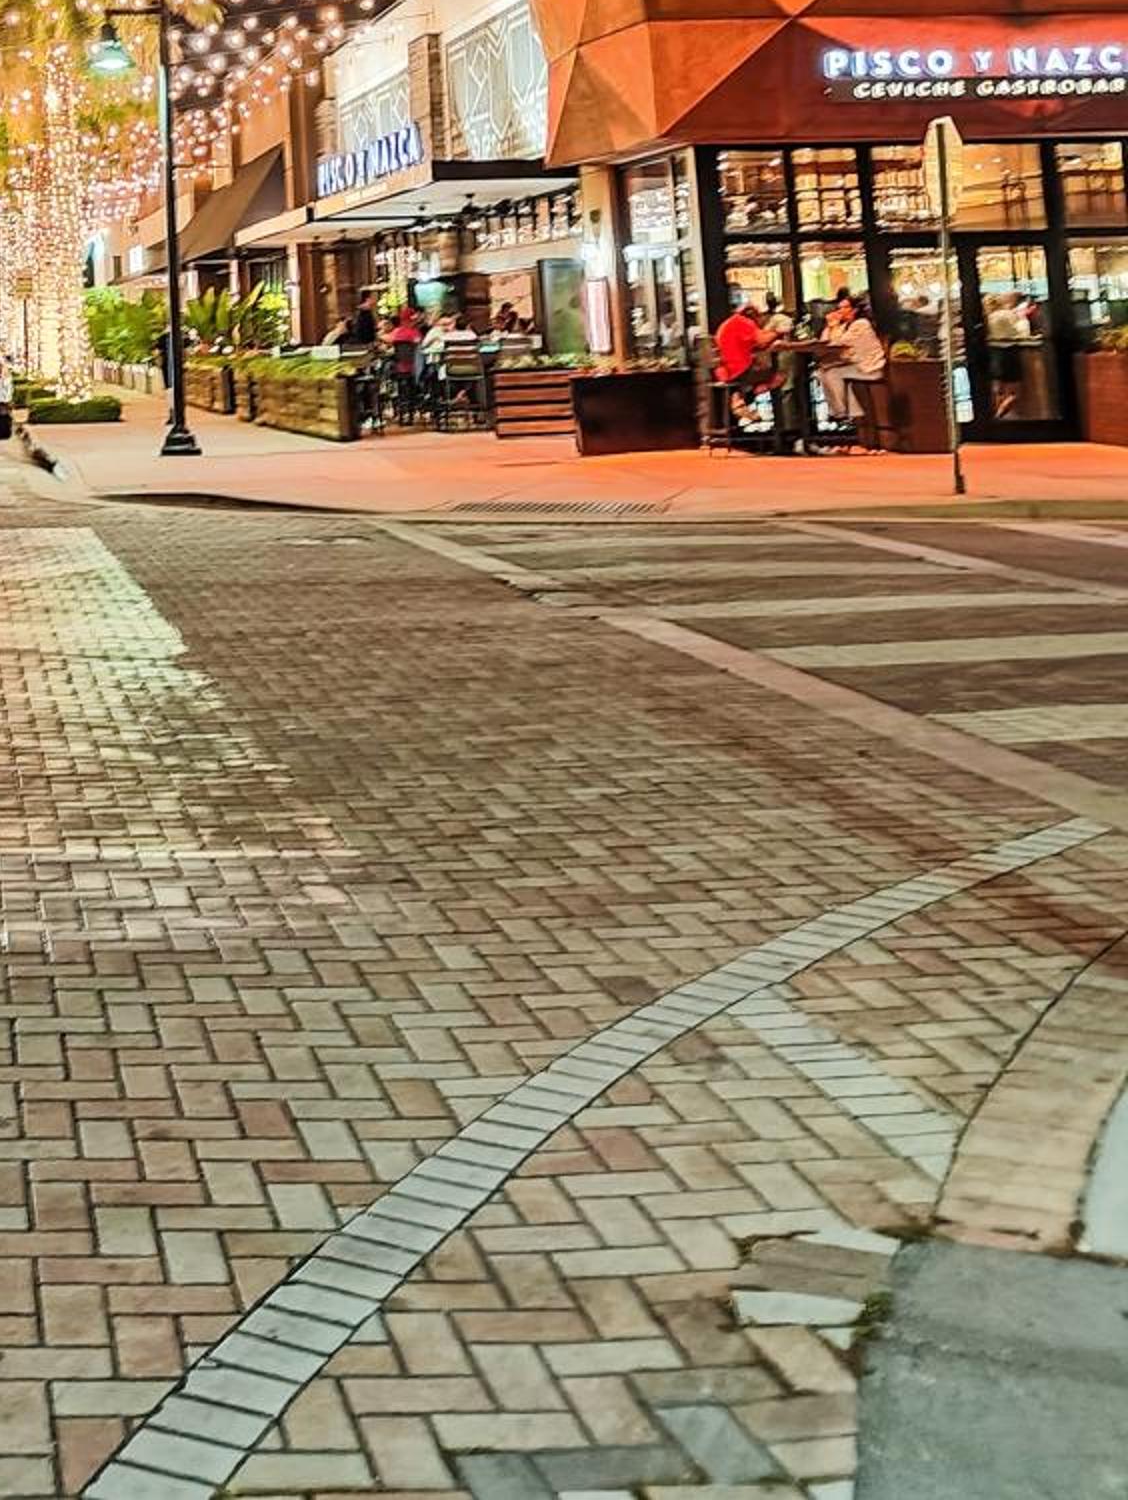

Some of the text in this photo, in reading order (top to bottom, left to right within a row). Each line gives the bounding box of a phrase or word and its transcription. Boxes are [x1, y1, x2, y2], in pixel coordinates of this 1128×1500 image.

[824, 46, 1127, 78] PISCO Y NAZC
[853, 77, 1126, 98] CEVICHE GASTROBAR
